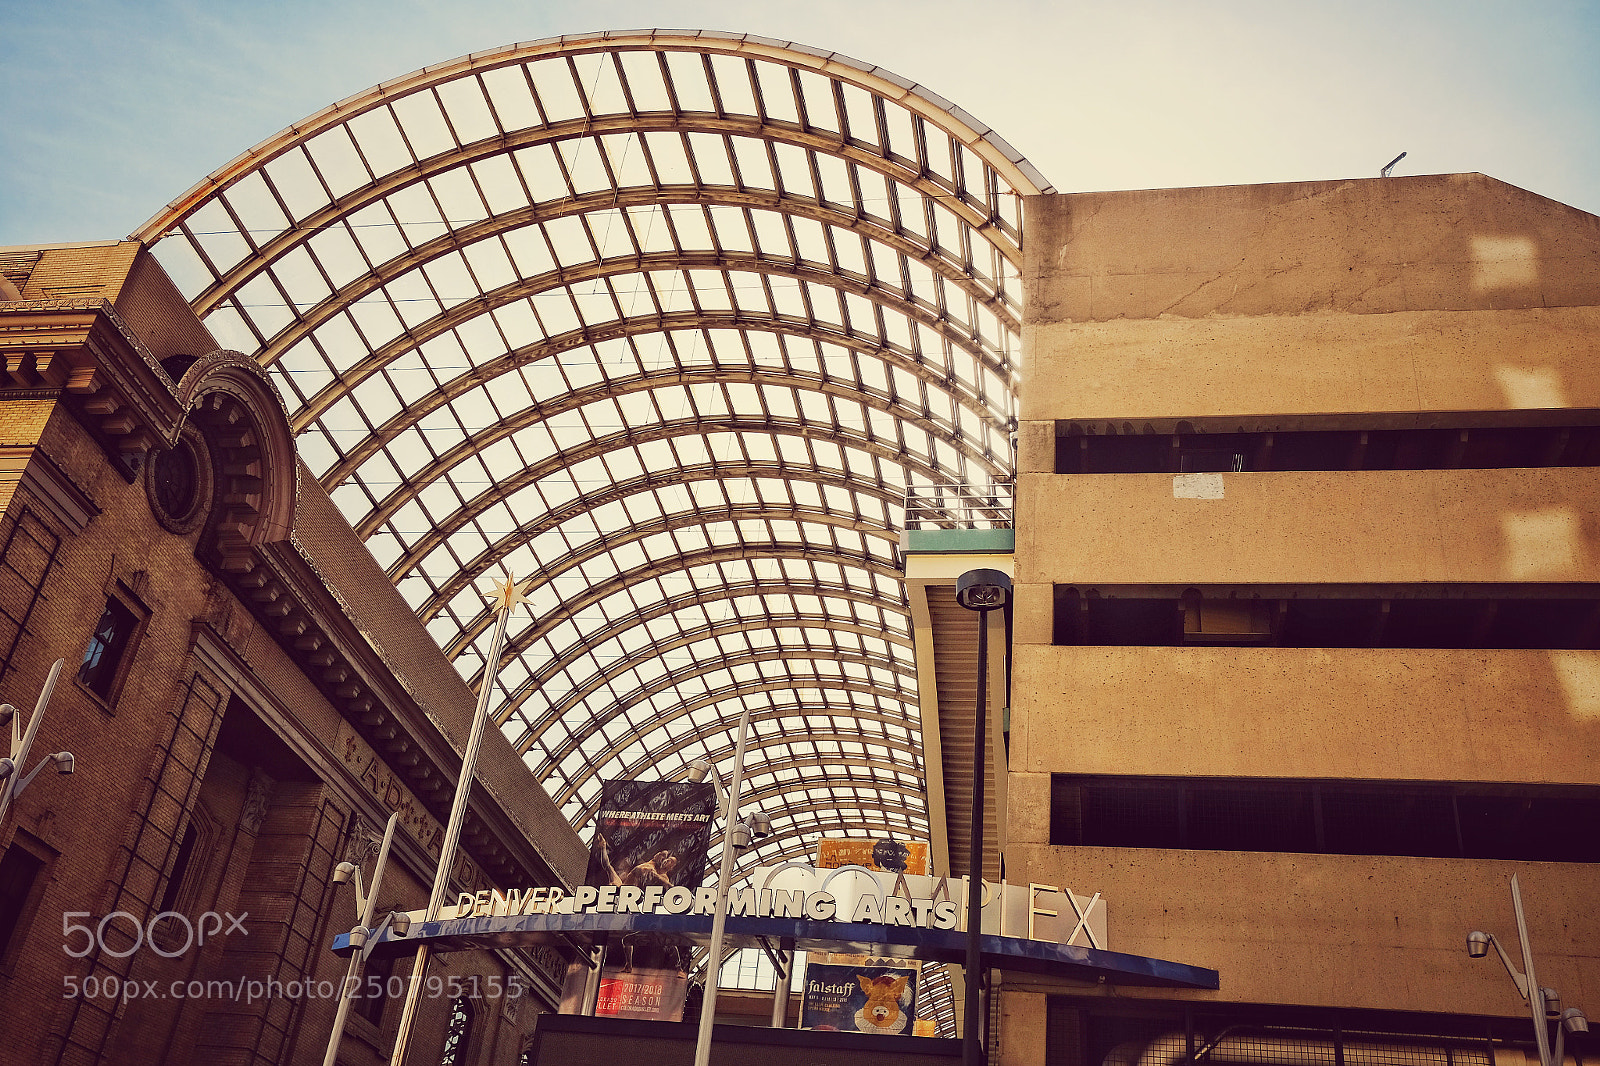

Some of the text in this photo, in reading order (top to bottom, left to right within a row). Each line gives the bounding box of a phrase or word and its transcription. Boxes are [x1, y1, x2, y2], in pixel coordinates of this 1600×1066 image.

[601, 810, 711, 823] WHERE ATHLETE MEETS ART
[456, 887, 564, 918] DENVER
[573, 885, 837, 921] PERFORMING
[851, 893, 958, 930] ARTS
[623, 983, 662, 995] 2017/2018
[807, 979, 856, 998] falstaff
[621, 994, 661, 1006] SEASON
